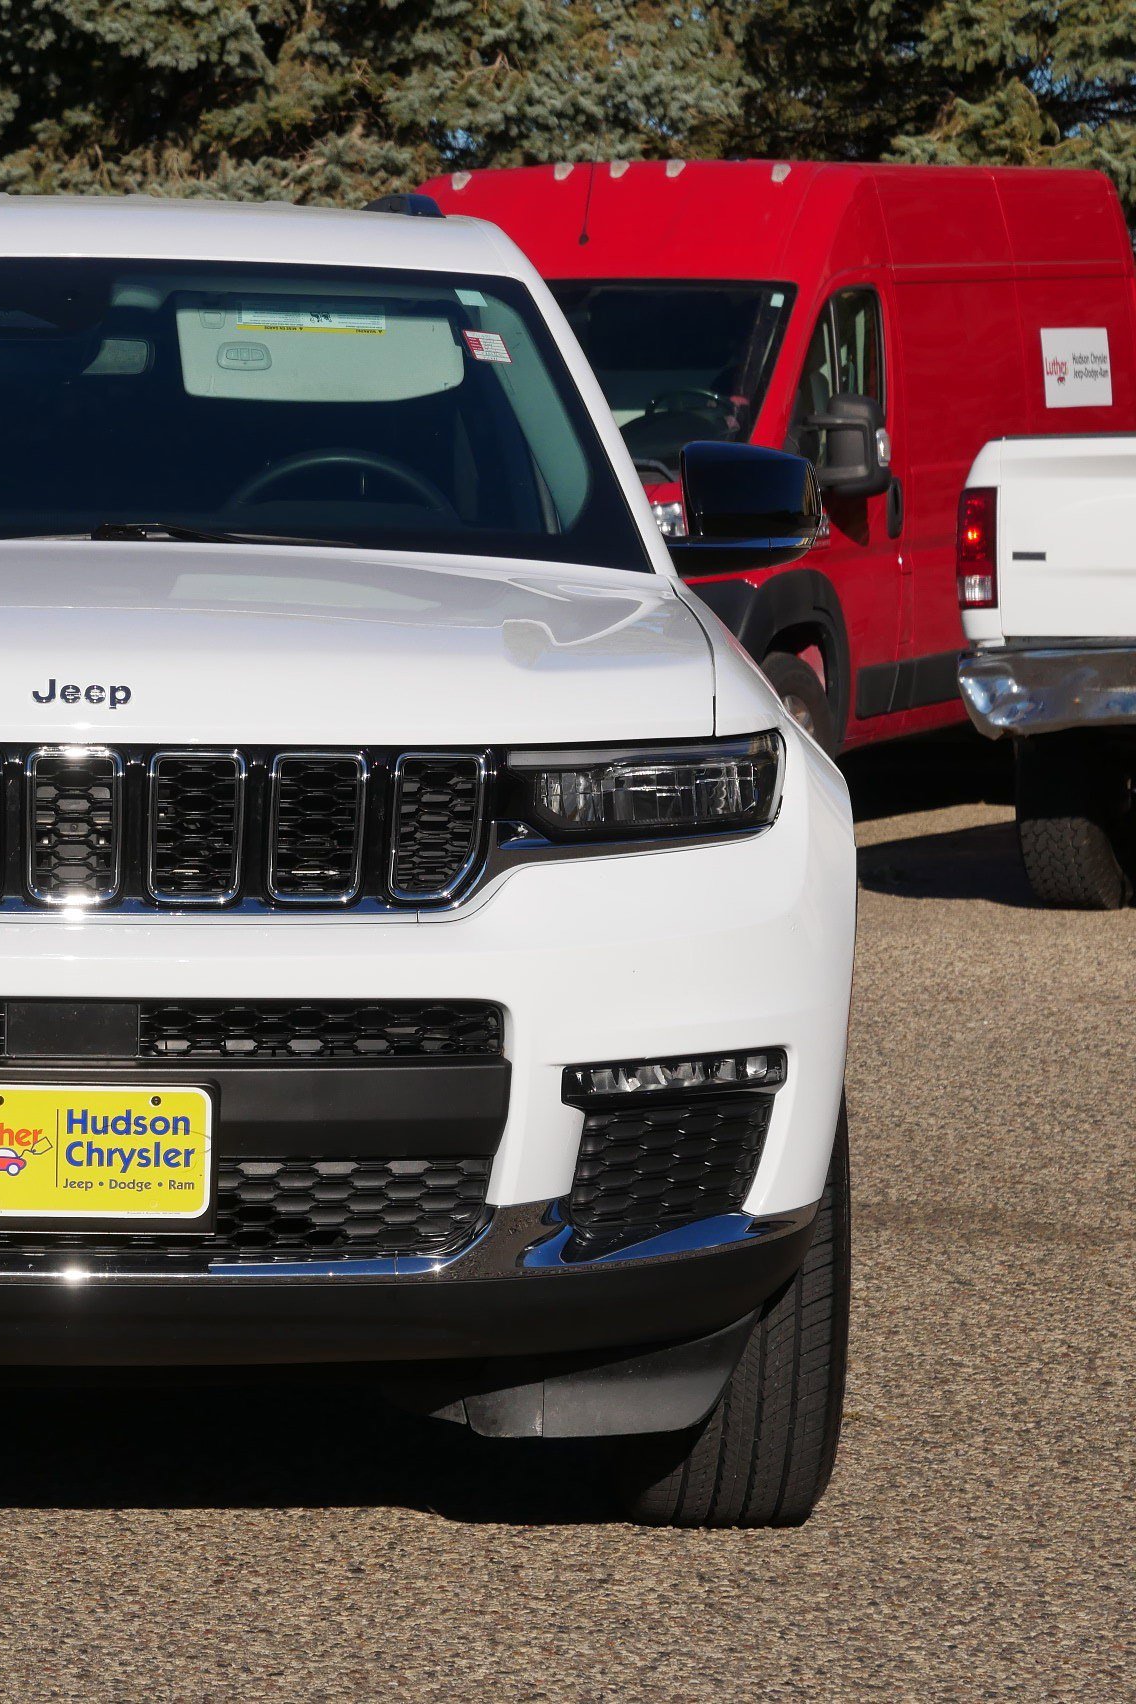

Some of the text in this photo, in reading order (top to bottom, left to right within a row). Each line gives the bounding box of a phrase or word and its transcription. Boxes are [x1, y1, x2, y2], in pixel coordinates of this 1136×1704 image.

[1045, 356, 1067, 376] Luther
[32, 679, 132, 709] Jeep
[66, 1109, 191, 1136] Hudson
[65, 1141, 196, 1174] Chrysler
[63, 1178, 195, 1191] Jeep Dodge Ram
